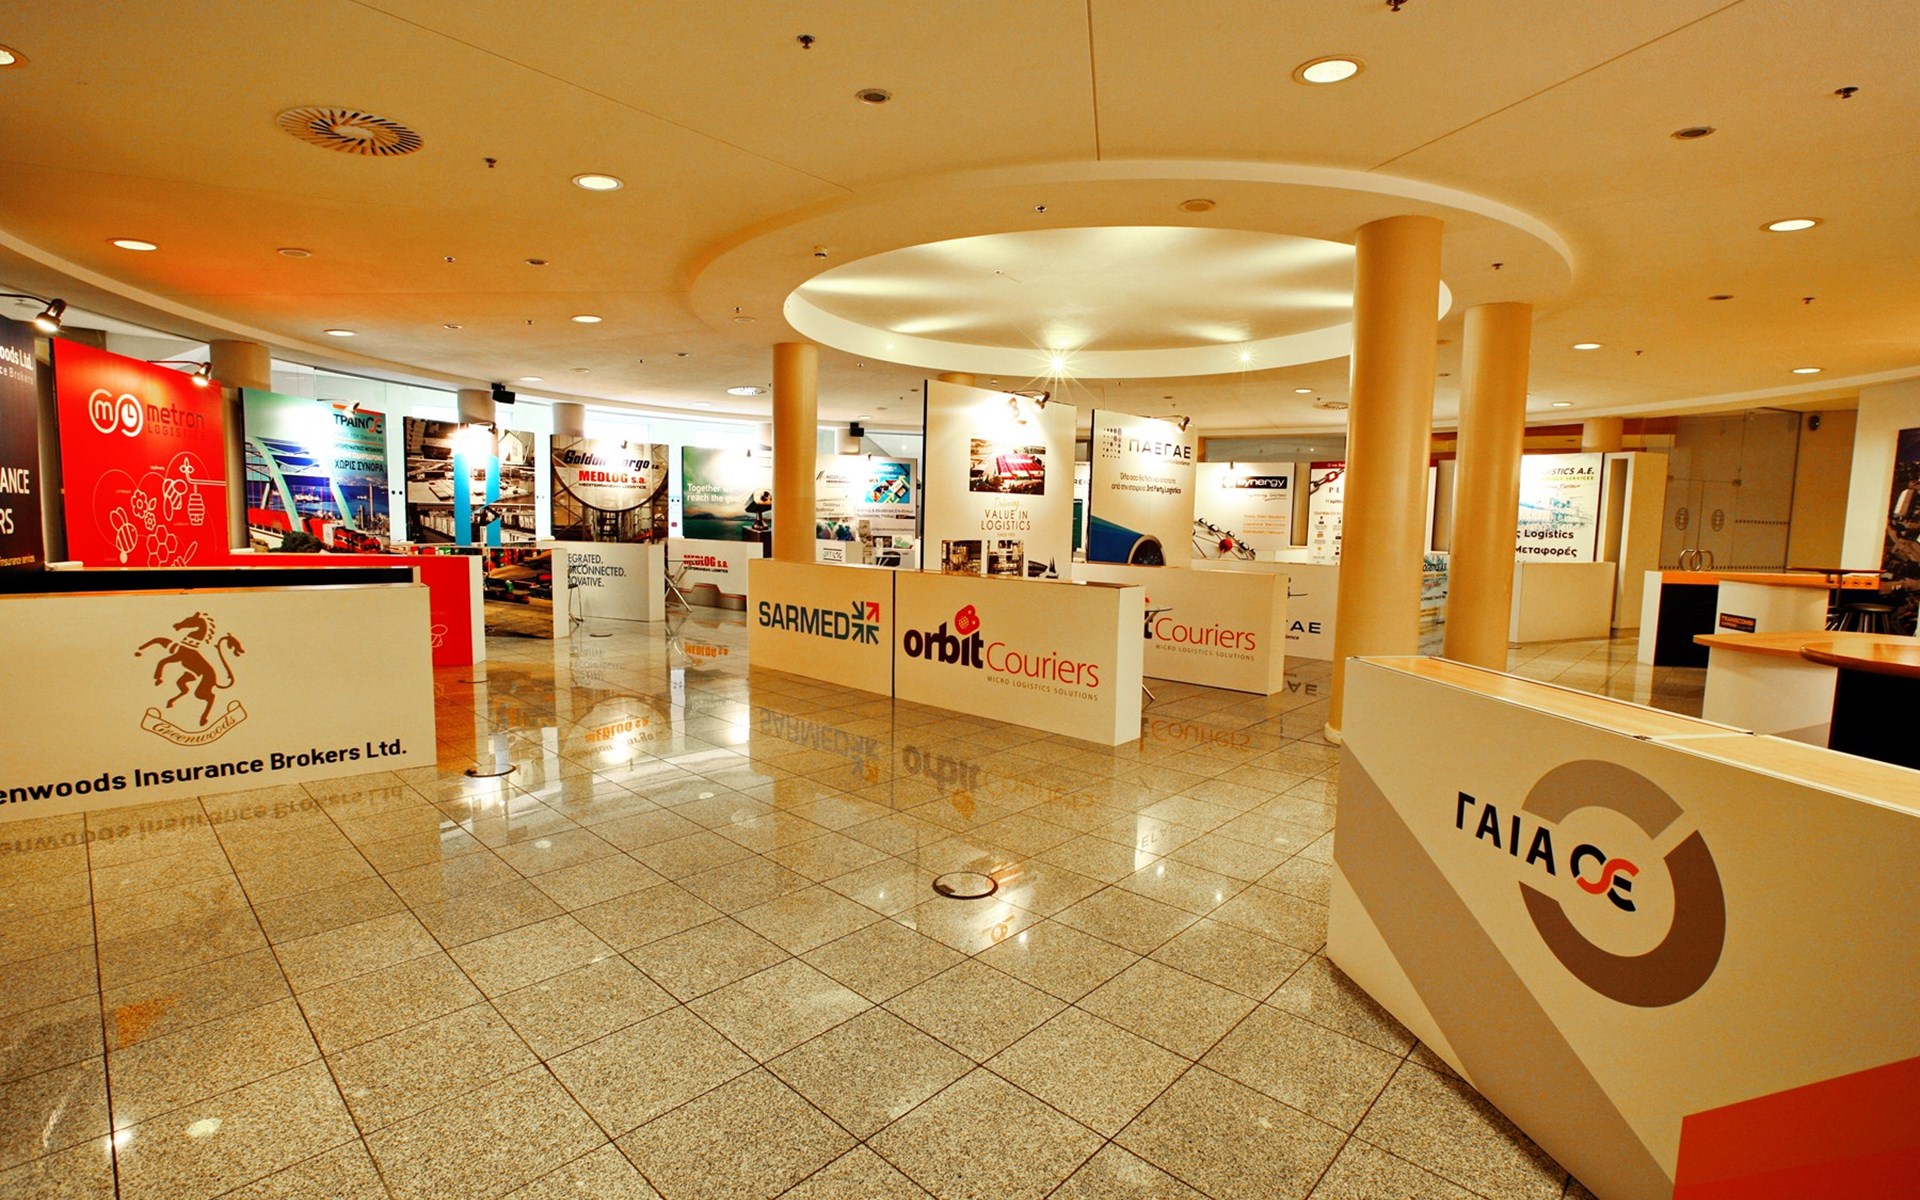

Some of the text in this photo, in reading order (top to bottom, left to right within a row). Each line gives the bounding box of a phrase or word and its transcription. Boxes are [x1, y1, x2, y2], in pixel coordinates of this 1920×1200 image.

[146, 403, 205, 430] metron
[1128, 438, 1192, 460] ΠΑΕΓΑΕ
[334, 459, 384, 473] ΧΩΡΙΣ ΣΥΝΟΡΑ
[1576, 467, 1595, 475] A.E.
[0, 467, 30, 494] ANCE
[578, 469, 629, 484] MEDLOG
[984, 509, 1029, 520] VALUE IN
[981, 519, 1031, 531] LOGISTICS
[1524, 529, 1574, 540] Logistics
[568, 564, 627, 578] RCONNECTED.
[568, 576, 605, 588] OVATIVE.
[758, 600, 850, 641] SARMED
[1289, 620, 1321, 634] ΑΕ
[1178, 646, 1213, 657] LOGISTICS
[1215, 650, 1256, 662] SOLUTIONS
[986, 675, 1099, 702] MICRO LOGISTICS SOLUTIONS
[152, 716, 236, 744] Greenwoods
[134, 759, 264, 788] Insurance
[270, 748, 361, 771] Brokers
[366, 738, 407, 759] Ltd.
